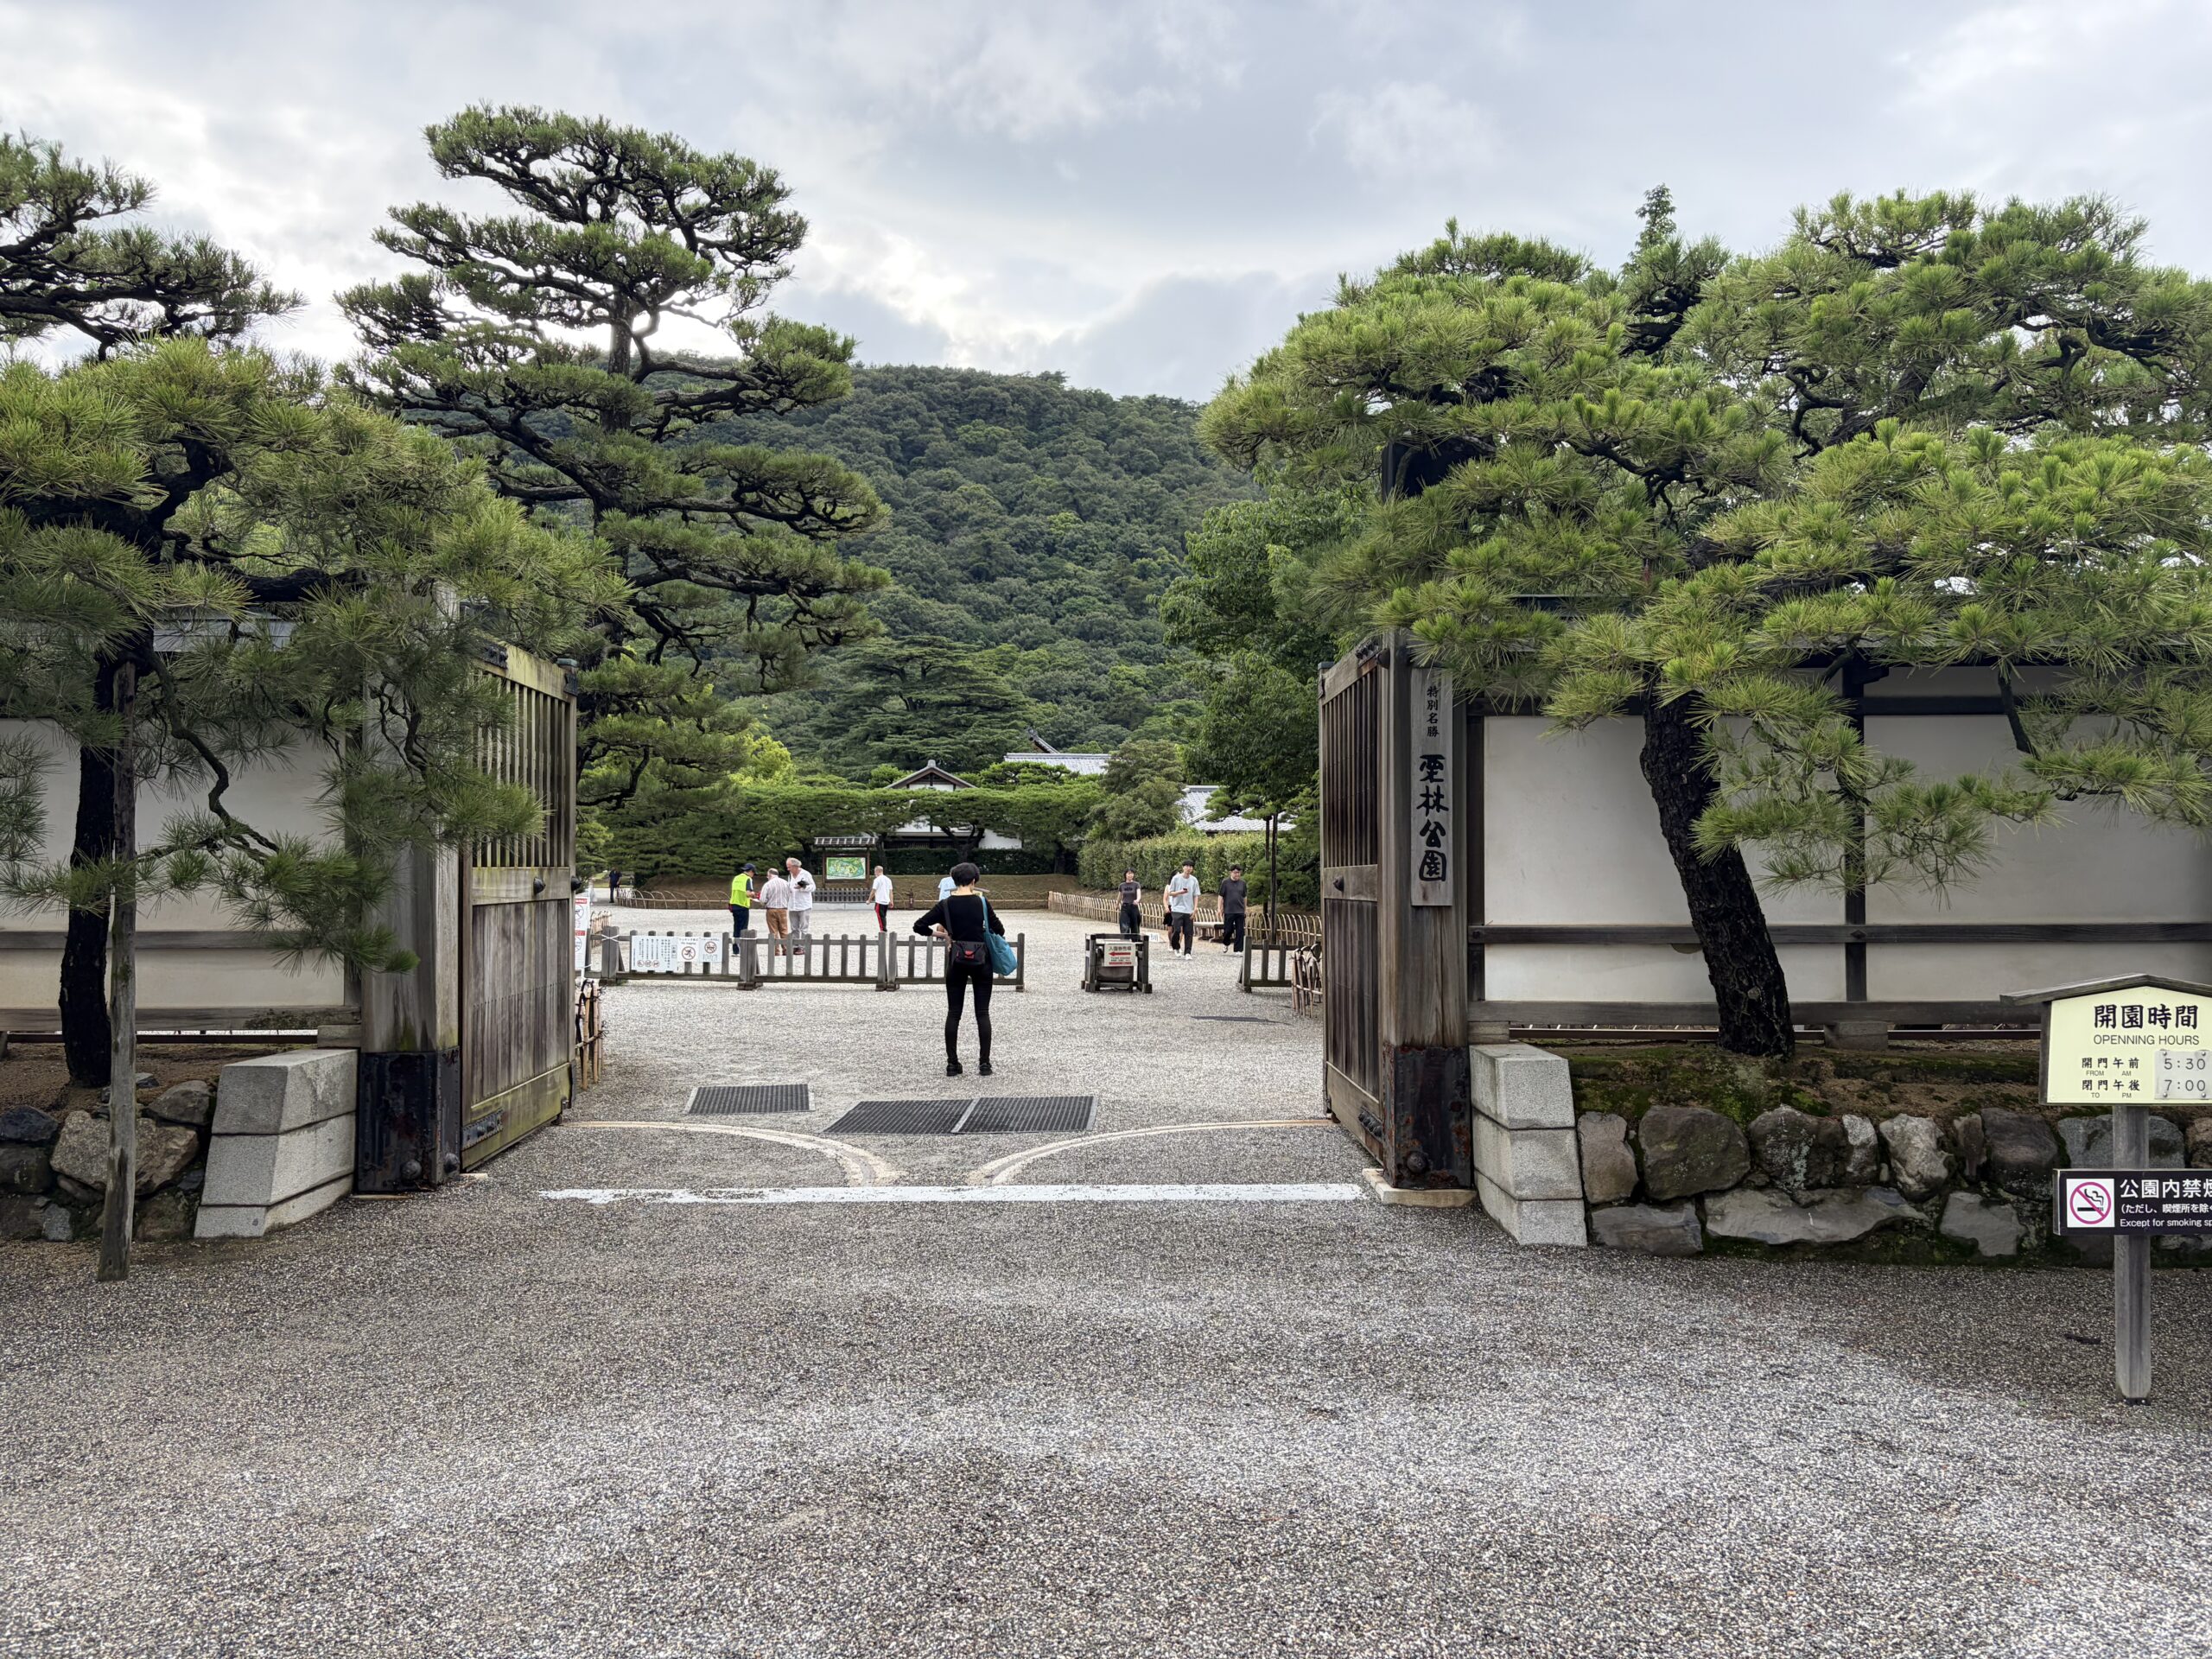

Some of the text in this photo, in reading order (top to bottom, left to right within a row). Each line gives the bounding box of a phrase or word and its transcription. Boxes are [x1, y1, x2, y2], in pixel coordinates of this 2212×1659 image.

[1426, 685, 1440, 738] 特別名勝
[1416, 753, 1450, 882] 栗林公園
[2094, 1003, 2199, 1030] 開園時間
[2094, 1034, 2200, 1046] OPENNING HOURS
[2164, 1058, 2206, 1071] 5:30
[2164, 1079, 2206, 1091] 7:00
[2120, 1218, 2150, 1228] Except
[2152, 1218, 2164, 1227] for
[2167, 1218, 2202, 1228] smoking
